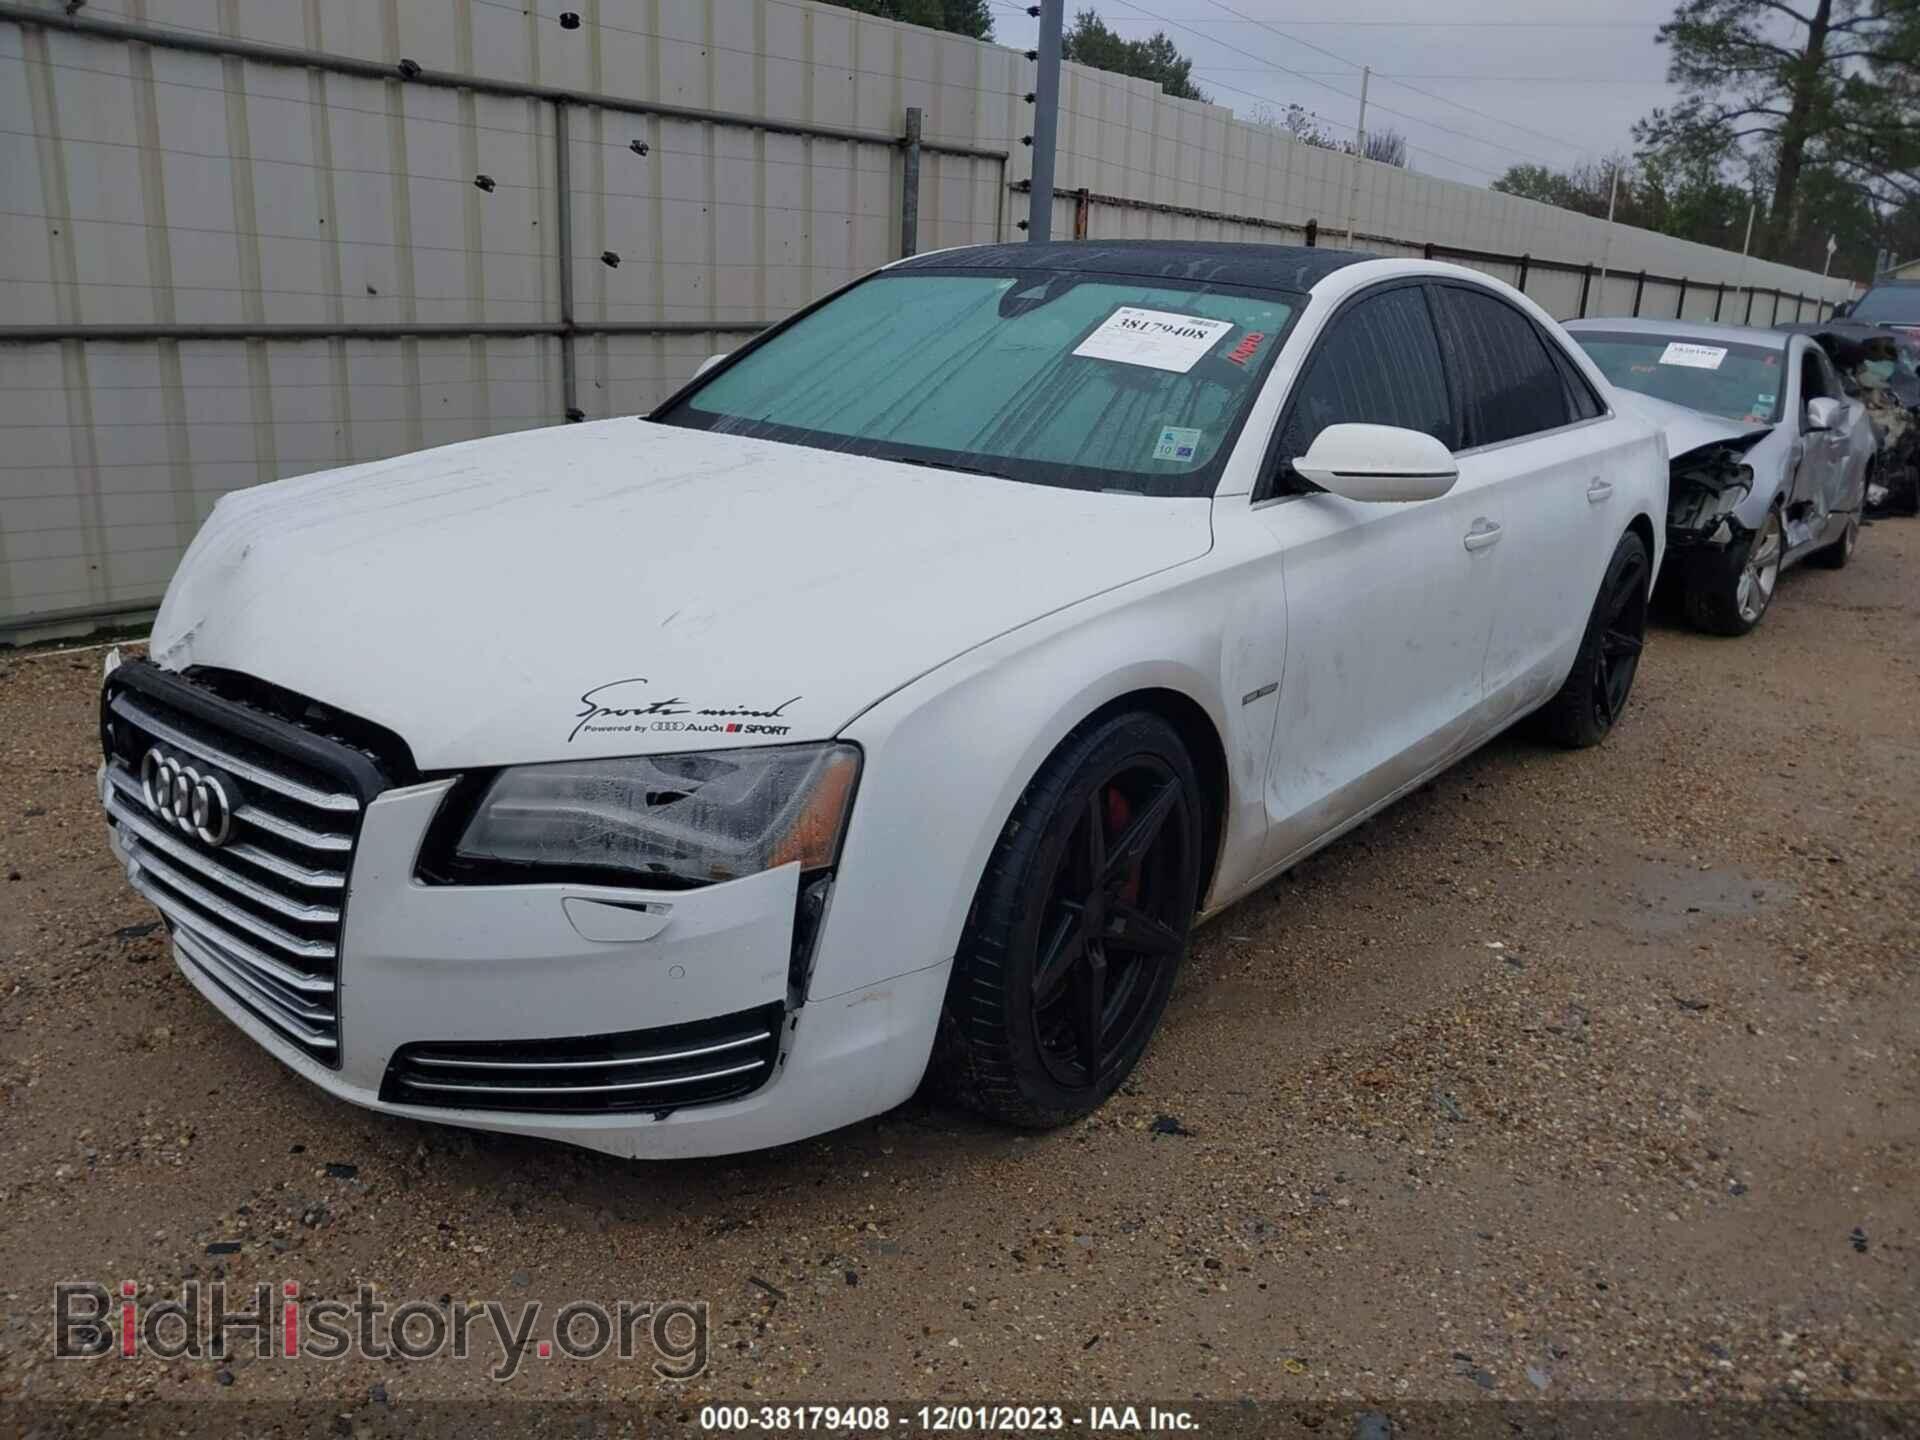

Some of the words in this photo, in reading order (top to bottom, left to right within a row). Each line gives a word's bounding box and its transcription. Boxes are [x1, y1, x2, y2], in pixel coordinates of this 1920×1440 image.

[1114, 317, 1209, 340] 38179408
[697, 696, 803, 718] mind
[584, 724, 631, 733] Powered
[634, 724, 648, 734] by
[684, 722, 724, 733] Audi
[744, 724, 791, 736] SPORT
